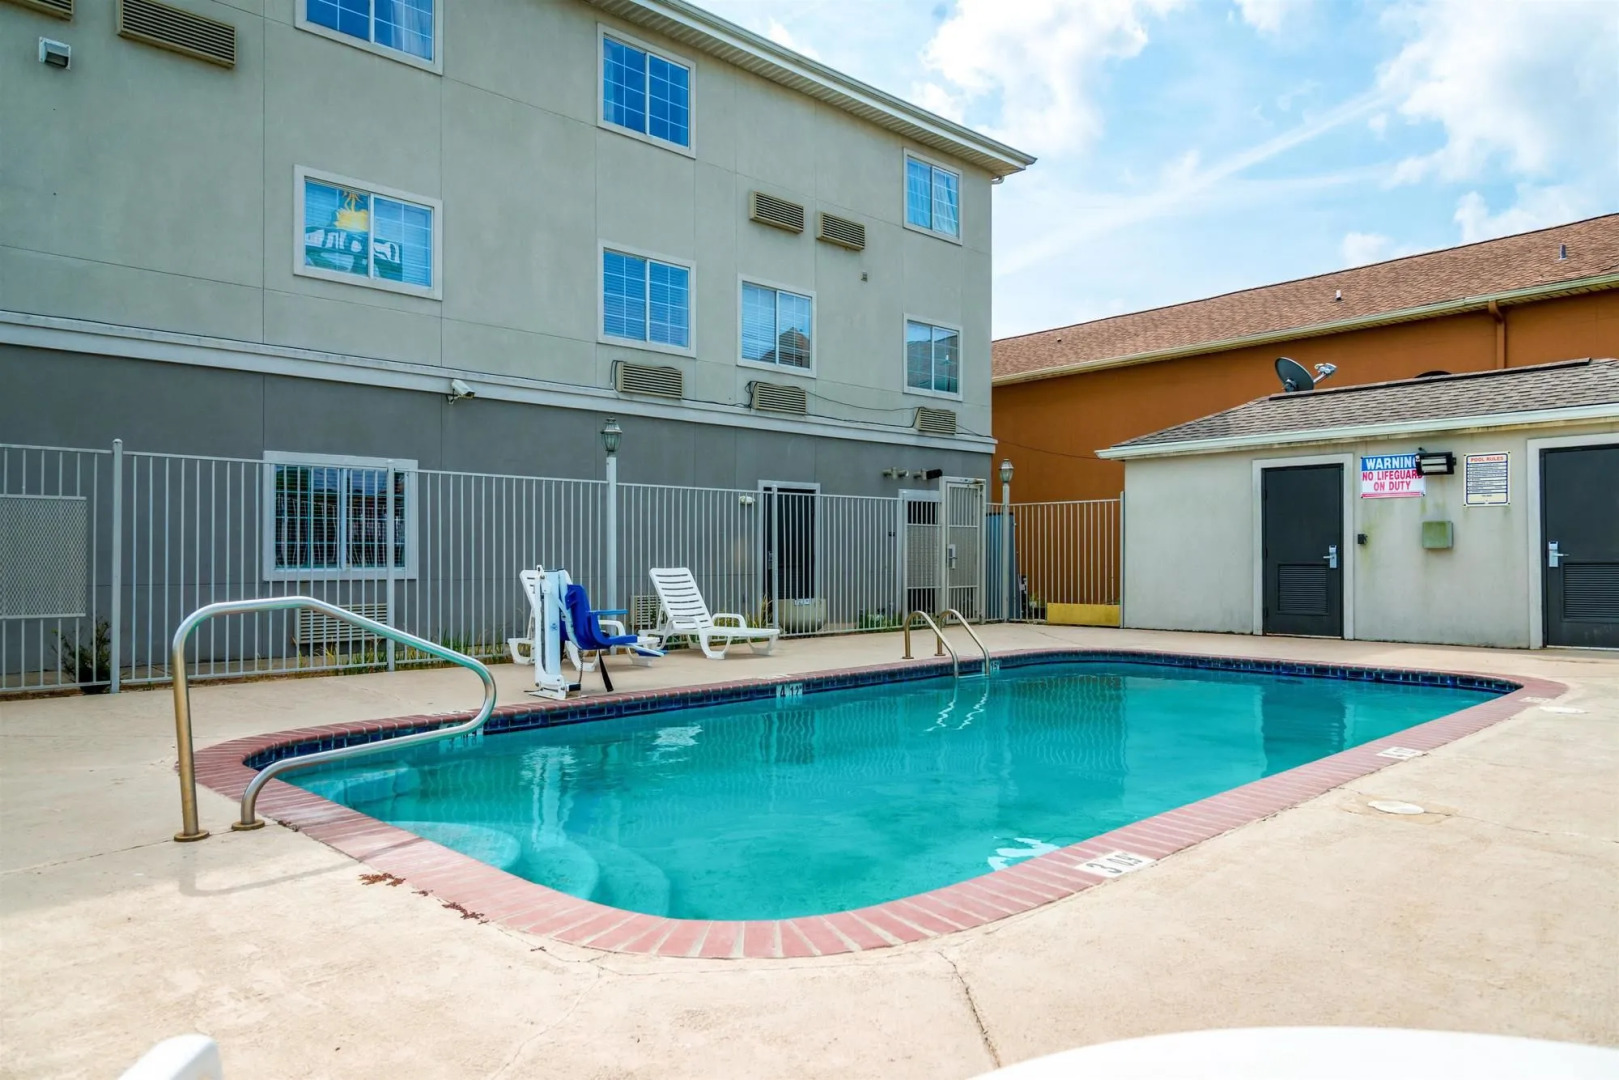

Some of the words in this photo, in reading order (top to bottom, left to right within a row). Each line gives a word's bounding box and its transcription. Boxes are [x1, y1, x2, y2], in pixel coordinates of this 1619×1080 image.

[1362, 471, 1374, 481] NO
[1373, 482, 1385, 491] ON
[1389, 481, 1411, 490] DUTY
